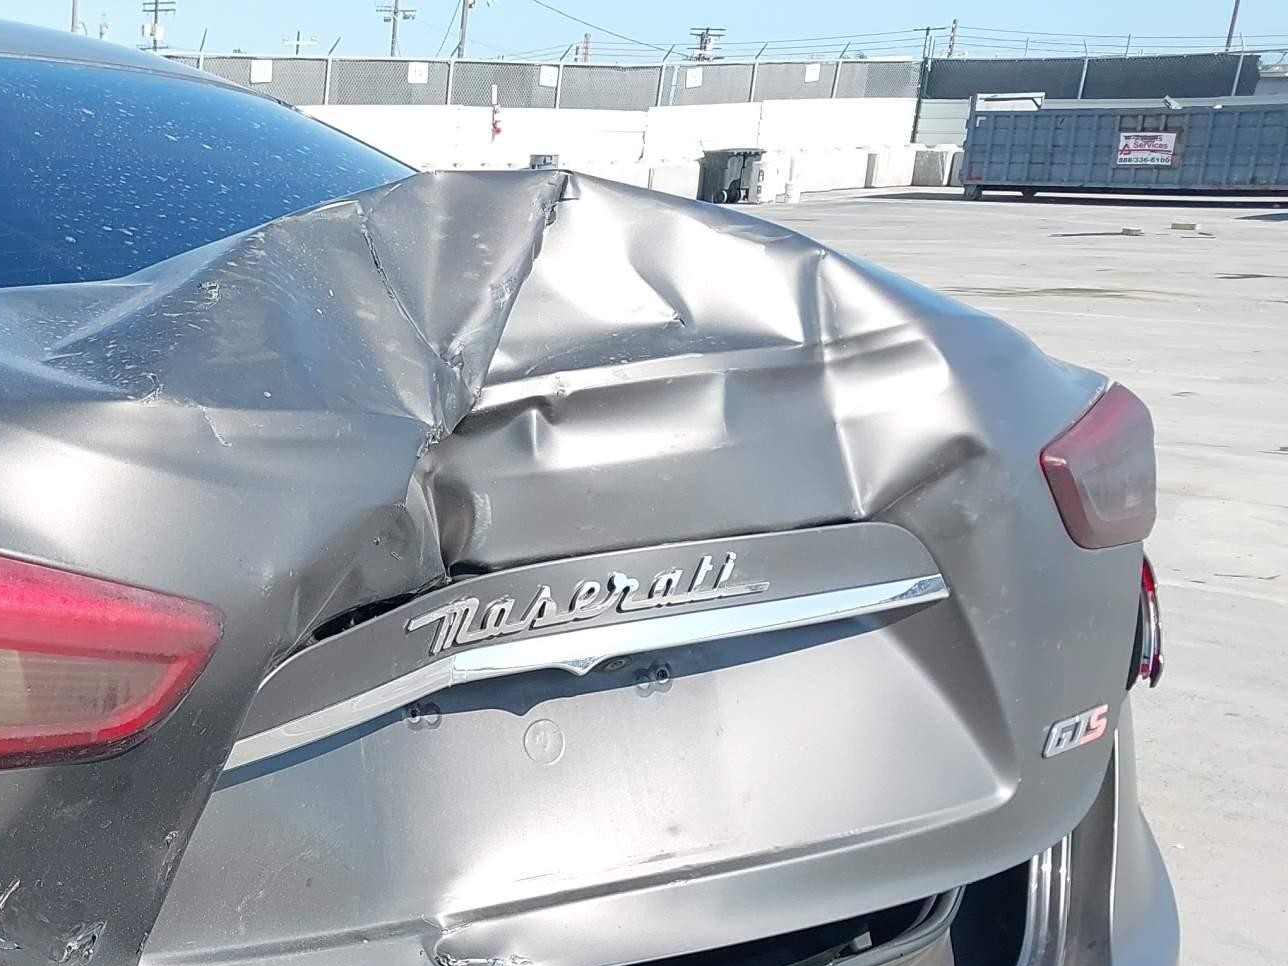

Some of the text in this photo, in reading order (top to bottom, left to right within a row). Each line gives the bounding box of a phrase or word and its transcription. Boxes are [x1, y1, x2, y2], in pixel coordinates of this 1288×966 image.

[1133, 141, 1168, 149] Services
[405, 551, 770, 656] Maserati
[1042, 703, 1109, 759] GTS
